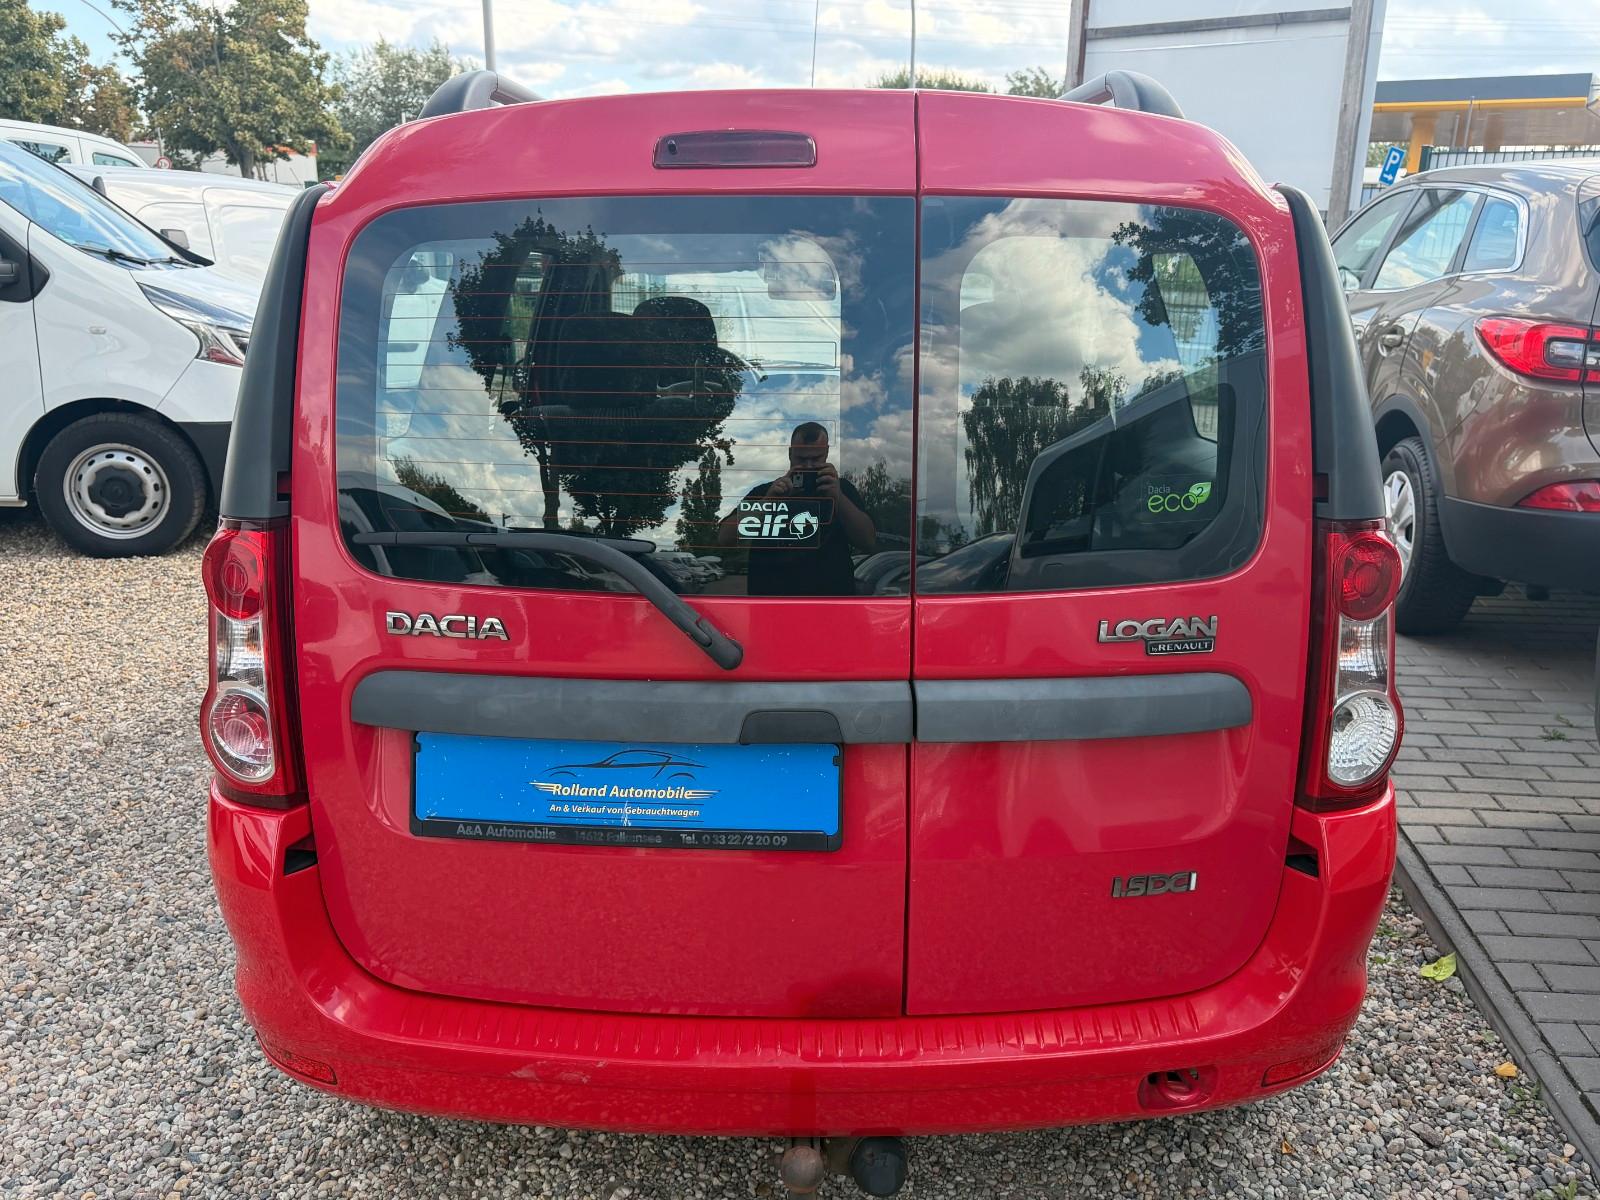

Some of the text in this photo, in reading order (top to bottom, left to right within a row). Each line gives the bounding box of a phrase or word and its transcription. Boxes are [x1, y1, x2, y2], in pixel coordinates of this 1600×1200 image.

[1385, 150, 1401, 171] P
[1148, 484, 1171, 494] Dacia
[740, 502, 789, 512] DACIA
[738, 514, 789, 537] elf
[385, 610, 511, 641] DACIA
[1098, 614, 1218, 643] LOGAN
[1158, 641, 1209, 652] RENAULT
[552, 783, 693, 800] Rolland Automobile
[549, 804, 562, 812] An
[562, 804, 570, 813] &
[571, 804, 606, 814] Verkauf
[624, 806, 700, 818] Gebrauchtwagen
[456, 823, 557, 840] A&A Automobile
[606, 832, 663, 844] Falnsee
[680, 833, 699, 845] Tel.
